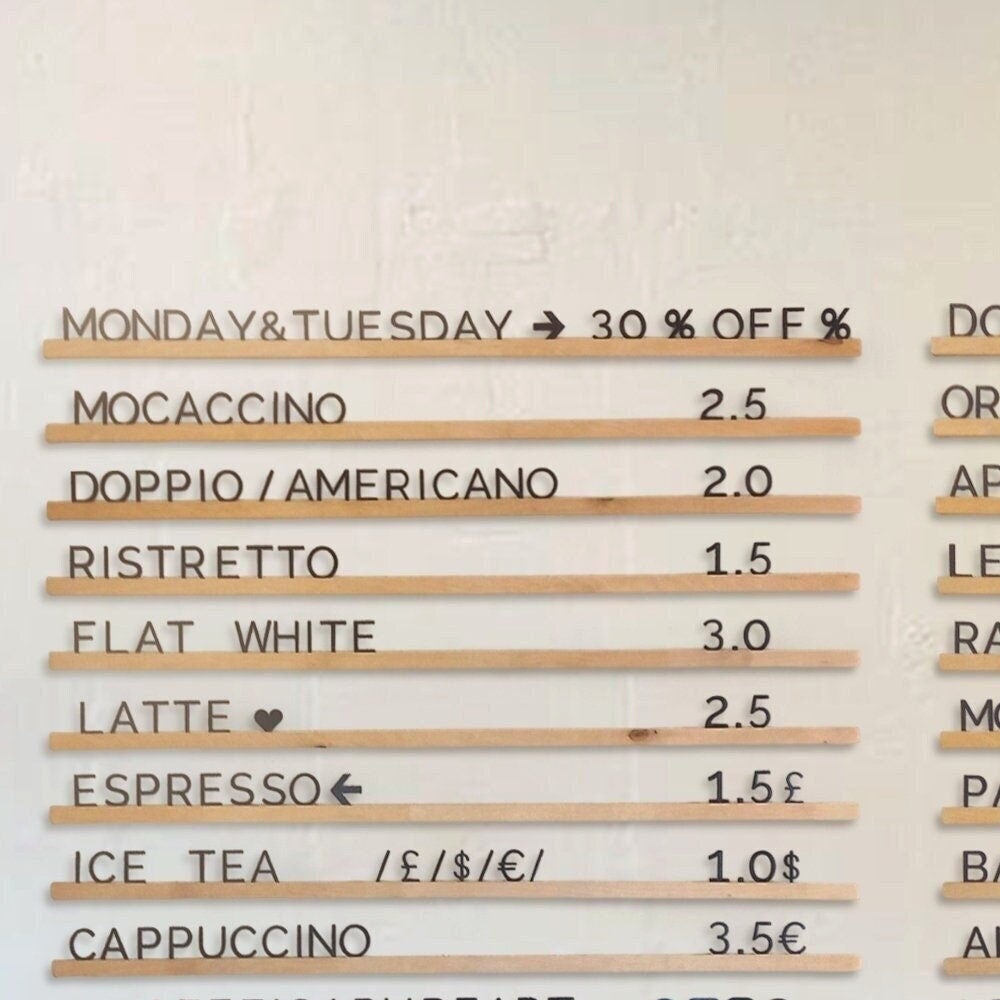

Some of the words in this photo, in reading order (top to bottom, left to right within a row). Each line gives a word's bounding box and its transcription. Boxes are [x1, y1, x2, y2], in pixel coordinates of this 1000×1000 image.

[62, 307, 513, 341] MONDAY&TUESDAY
[591, 308, 648, 340] 30
[711, 306, 806, 340] OFF
[72, 390, 347, 426] MOCACCINO
[696, 387, 767, 422] 2.5
[70, 468, 244, 503] DOPPIO
[702, 464, 773, 498] 2.0
[68, 544, 339, 579] RISTRETTO
[705, 541, 772, 575] 1.5
[73, 620, 195, 654] FLAT
[234, 619, 377, 654] WHITE
[700, 618, 772, 652] 3.0
[79, 699, 232, 734] LATTE
[703, 694, 772, 729] 2.5
[73, 772, 321, 807] ESPRESSO
[73, 850, 148, 884] ICE
[189, 849, 281, 884] TEA
[68, 923, 372, 960] CAPPUCCINO
